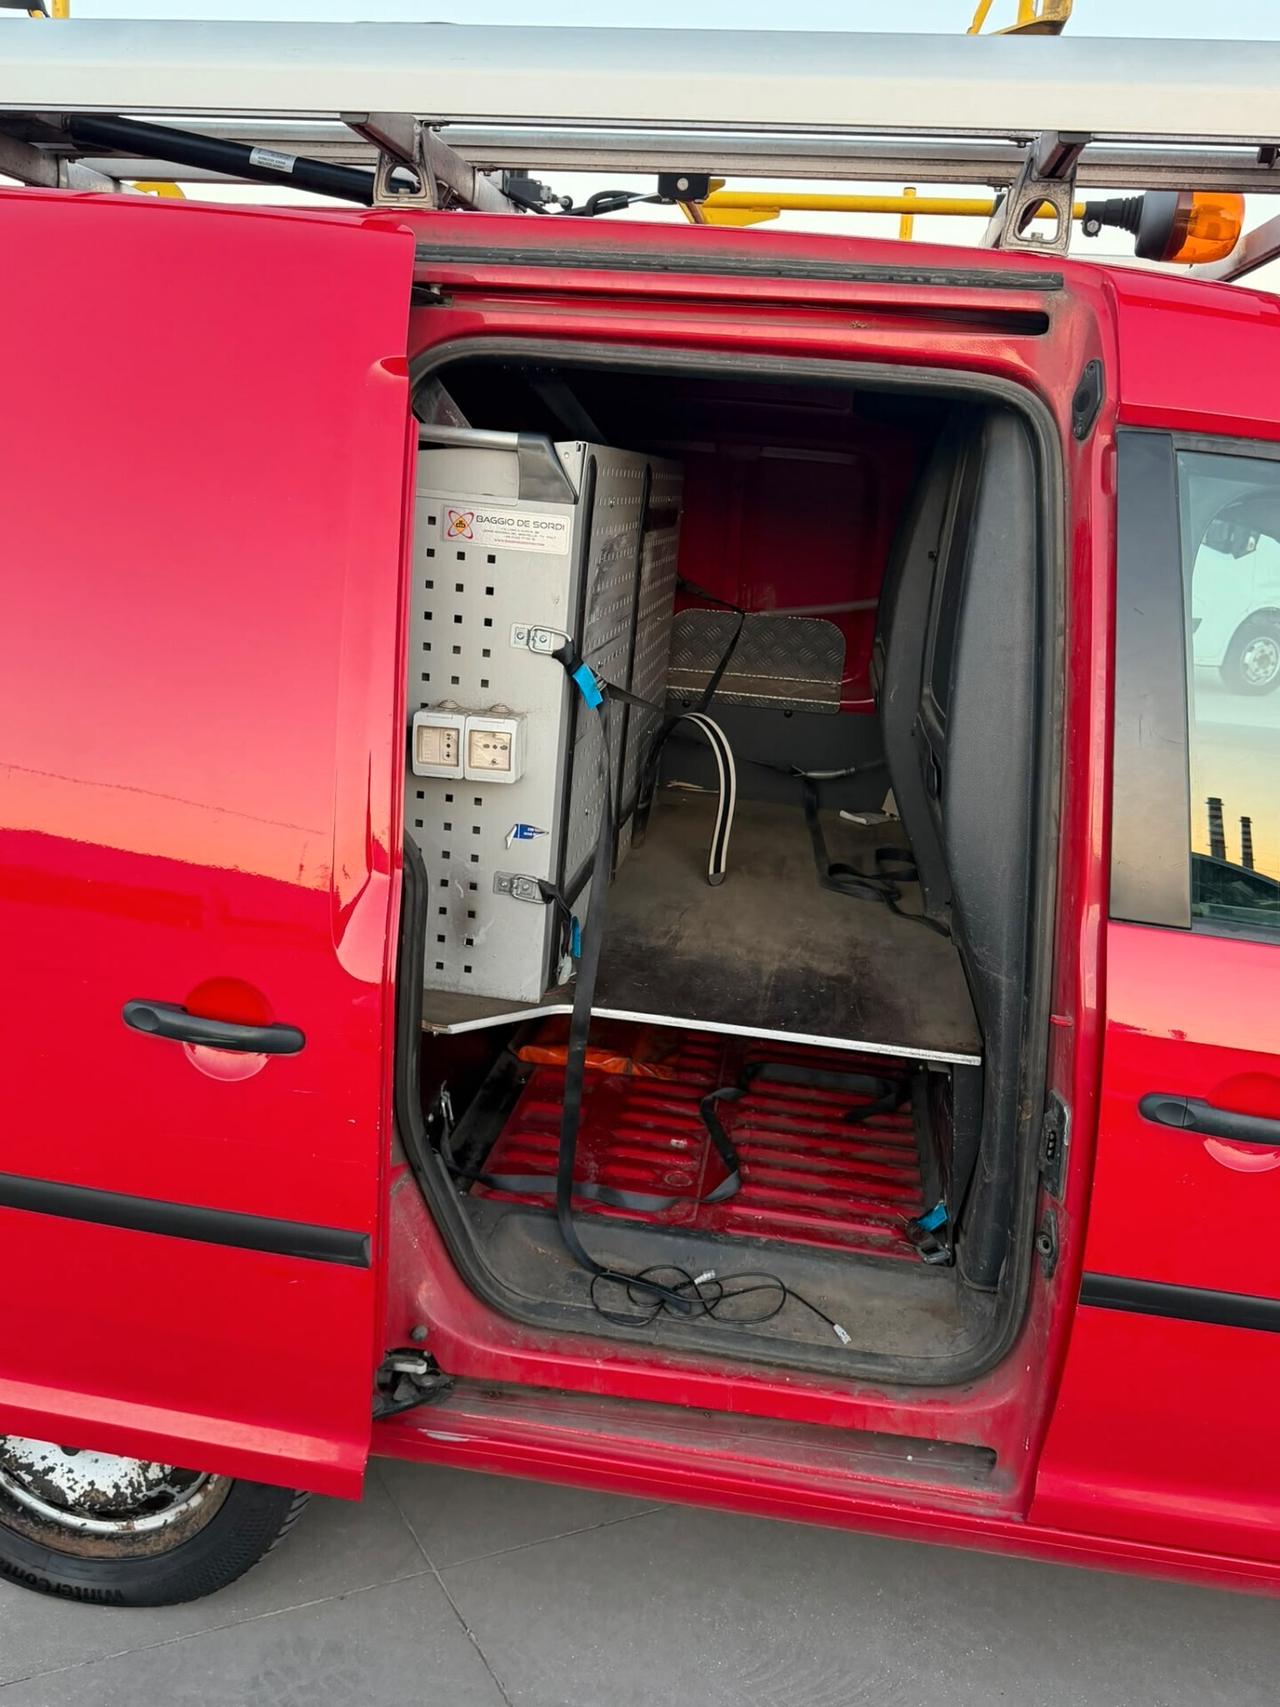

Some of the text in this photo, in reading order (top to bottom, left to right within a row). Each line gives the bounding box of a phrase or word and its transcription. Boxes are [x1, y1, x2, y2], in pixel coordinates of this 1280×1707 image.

[476, 515, 515, 526] BAGGIO
[517, 519, 530, 528] DE
[533, 521, 565, 531] SORDI
[0, 1558, 125, 1600] WinterCont
